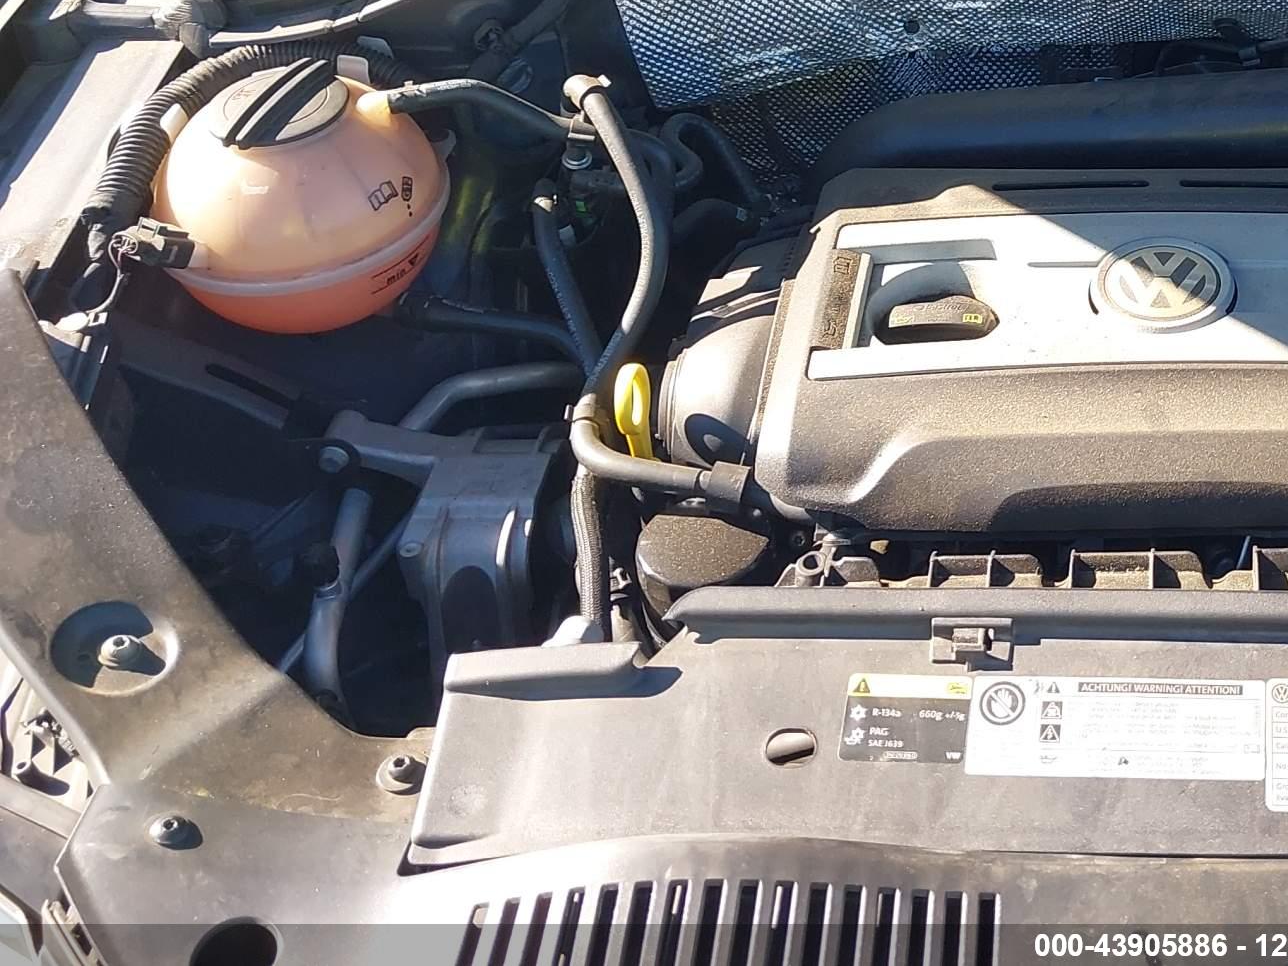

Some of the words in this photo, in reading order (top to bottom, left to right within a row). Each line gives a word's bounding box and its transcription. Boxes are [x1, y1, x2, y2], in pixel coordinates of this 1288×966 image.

[386, 268, 407, 286] min
[1081, 683, 1132, 693] ACHTUNG!
[1134, 684, 1184, 694] WARNING!
[1185, 685, 1240, 695] ATTENTION!
[871, 707, 903, 718] R-134a
[869, 727, 890, 737] PAG
[868, 738, 883, 748] SAE
[883, 739, 905, 749] J639
[945, 751, 961, 760] VW
